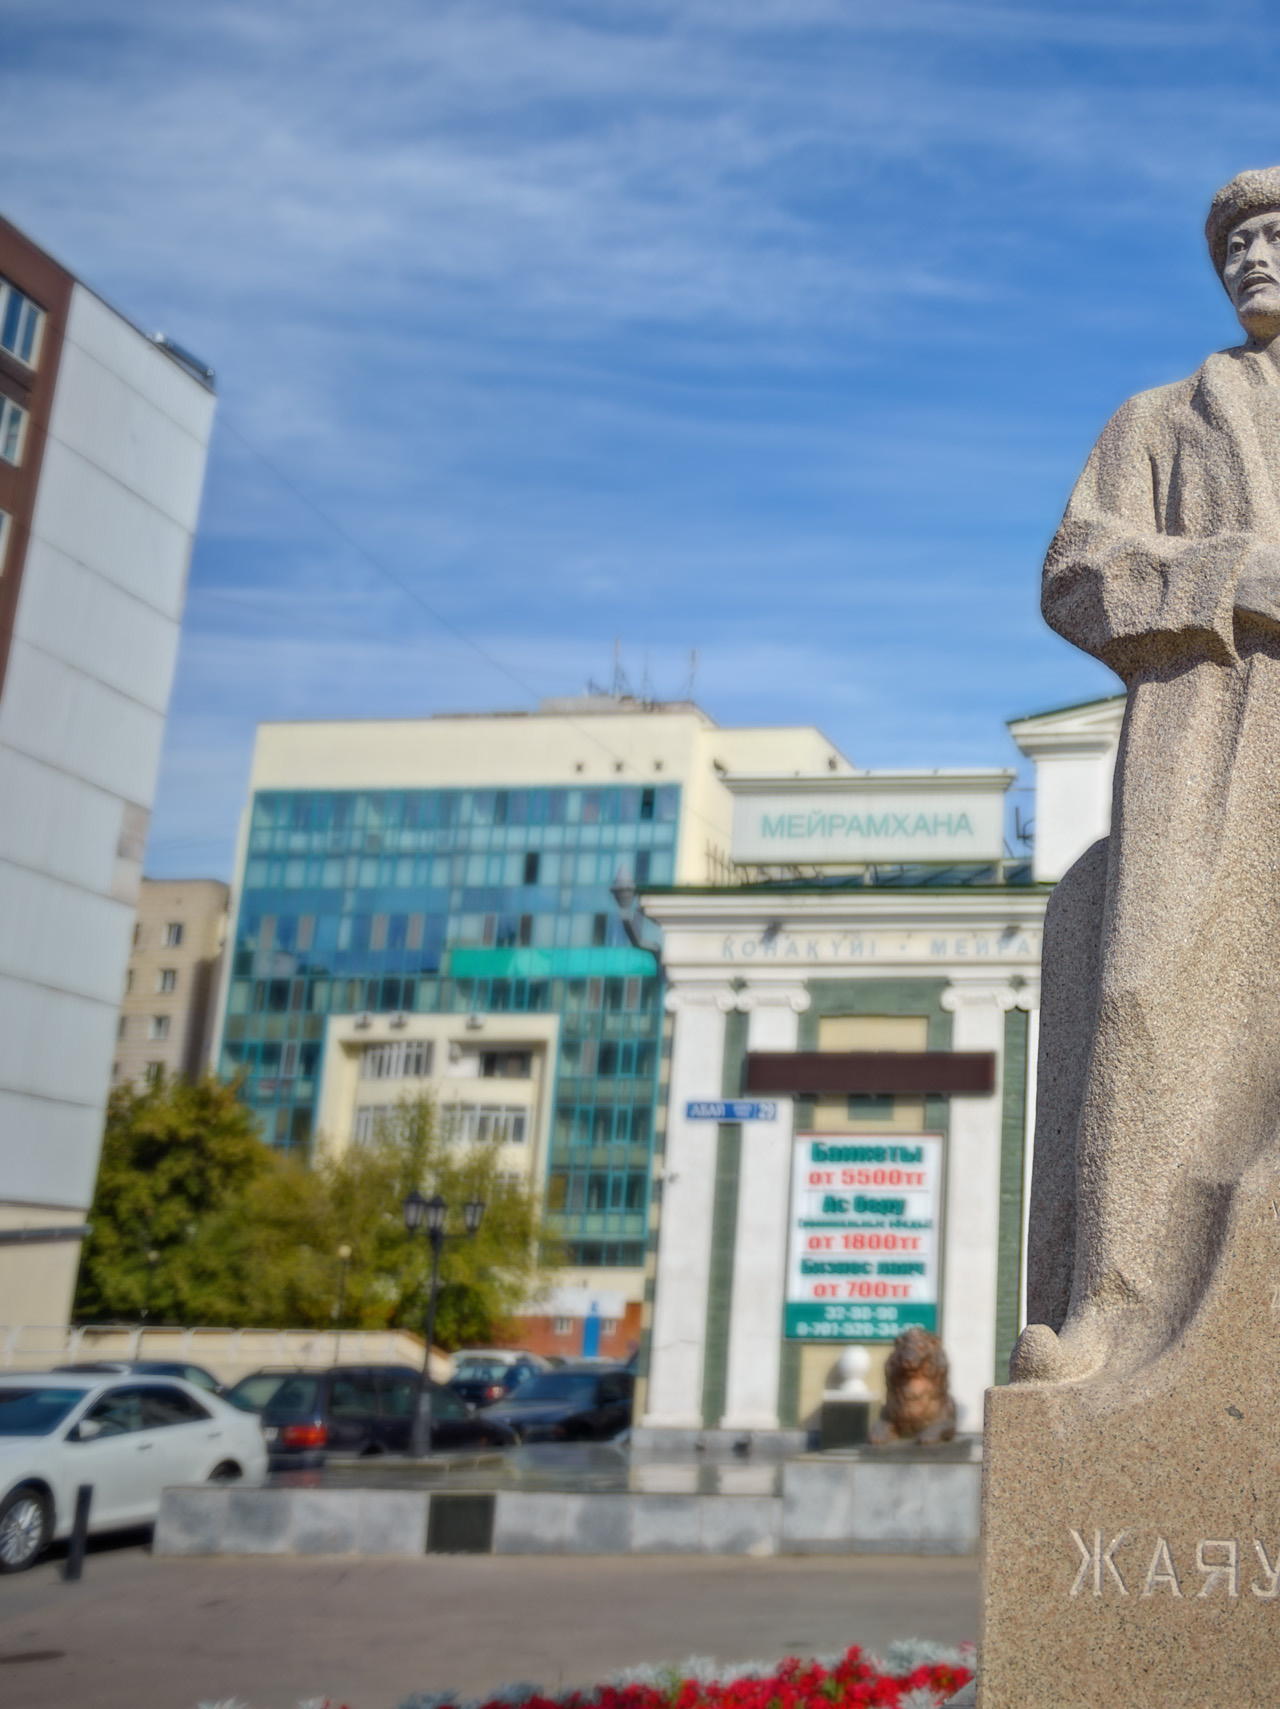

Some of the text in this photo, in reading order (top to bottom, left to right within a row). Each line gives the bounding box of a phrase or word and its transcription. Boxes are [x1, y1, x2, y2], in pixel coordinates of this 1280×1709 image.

[761, 809, 974, 839] МЕЙРАМХАНА
[811, 1142, 923, 1163] Банкеты
[809, 1169, 926, 1186] от 5500тг
[808, 1233, 921, 1250] от 1800тг
[813, 1281, 912, 1298] от 700тг
